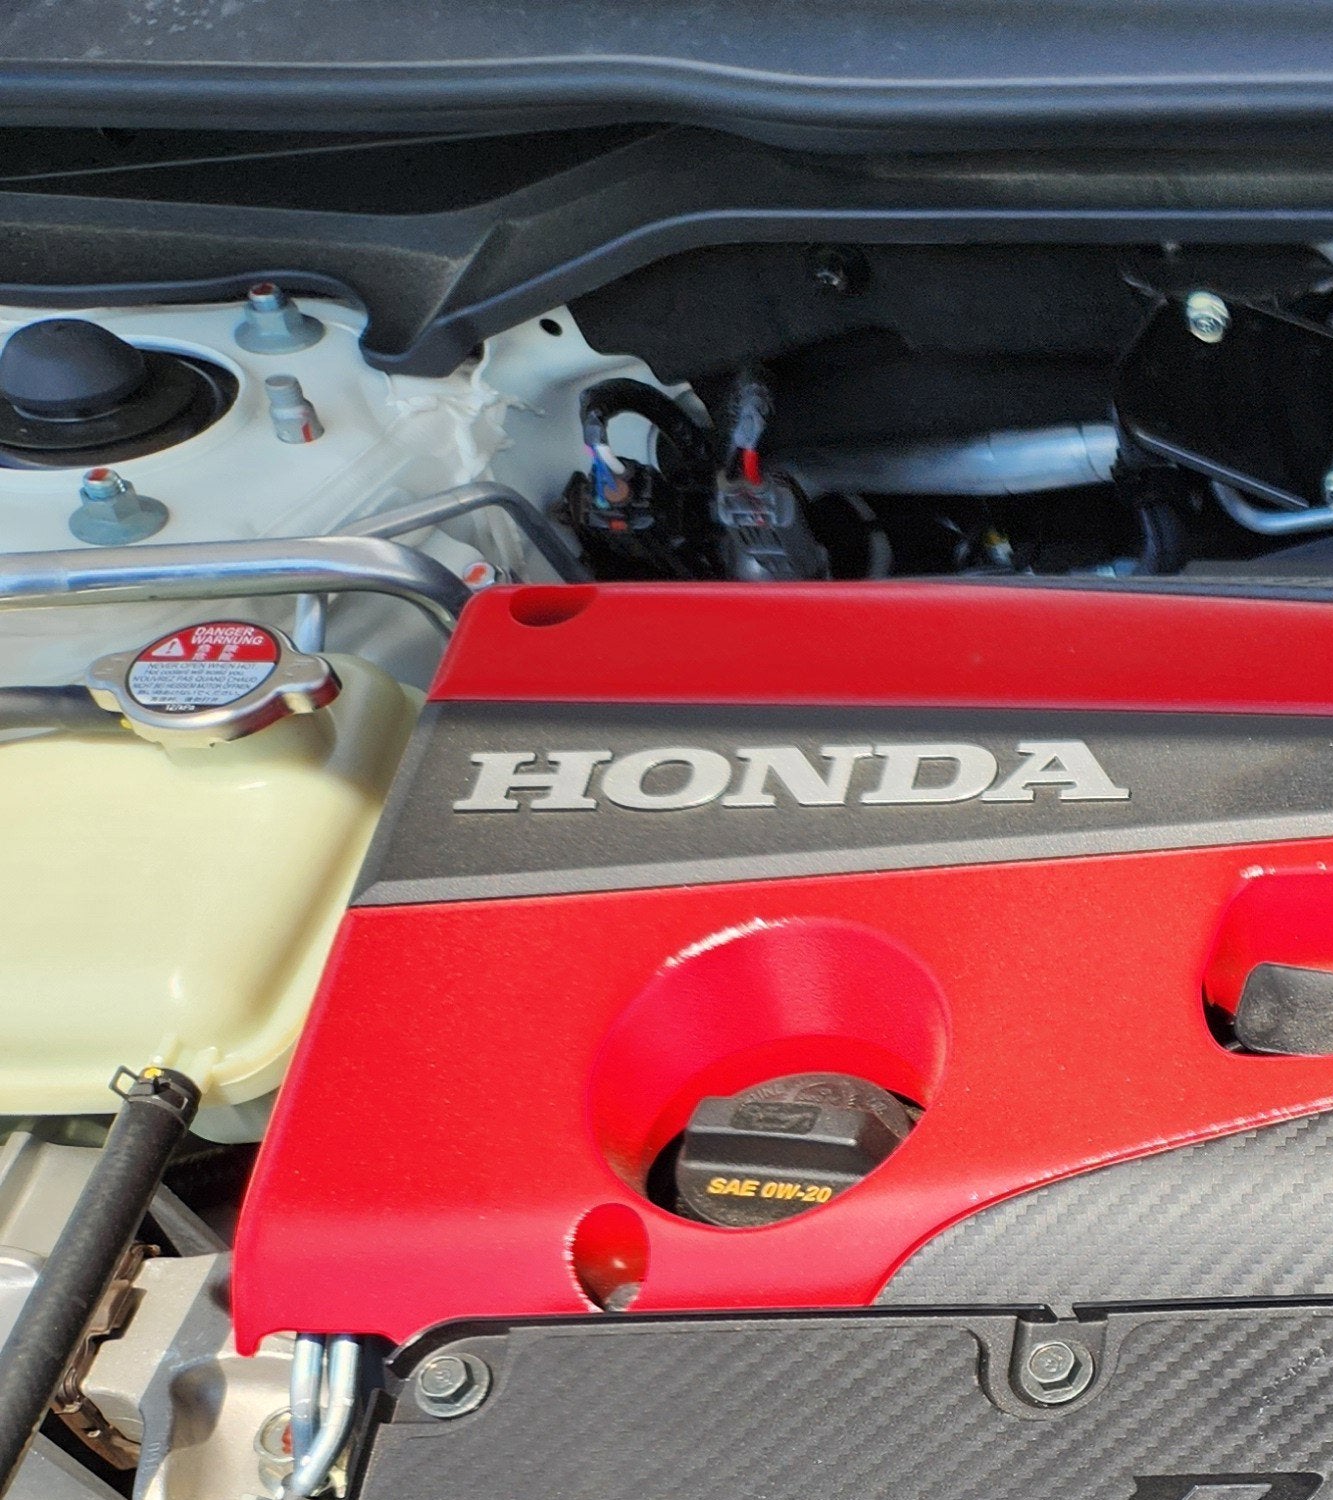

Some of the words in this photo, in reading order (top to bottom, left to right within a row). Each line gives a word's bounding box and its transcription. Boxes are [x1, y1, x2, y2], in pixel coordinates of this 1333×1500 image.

[191, 635, 264, 645] WARNUNG
[195, 626, 255, 636] DANGER
[453, 740, 1133, 813] HONDA
[707, 1176, 760, 1197] SAE
[760, 1181, 833, 1204] 0W-20
